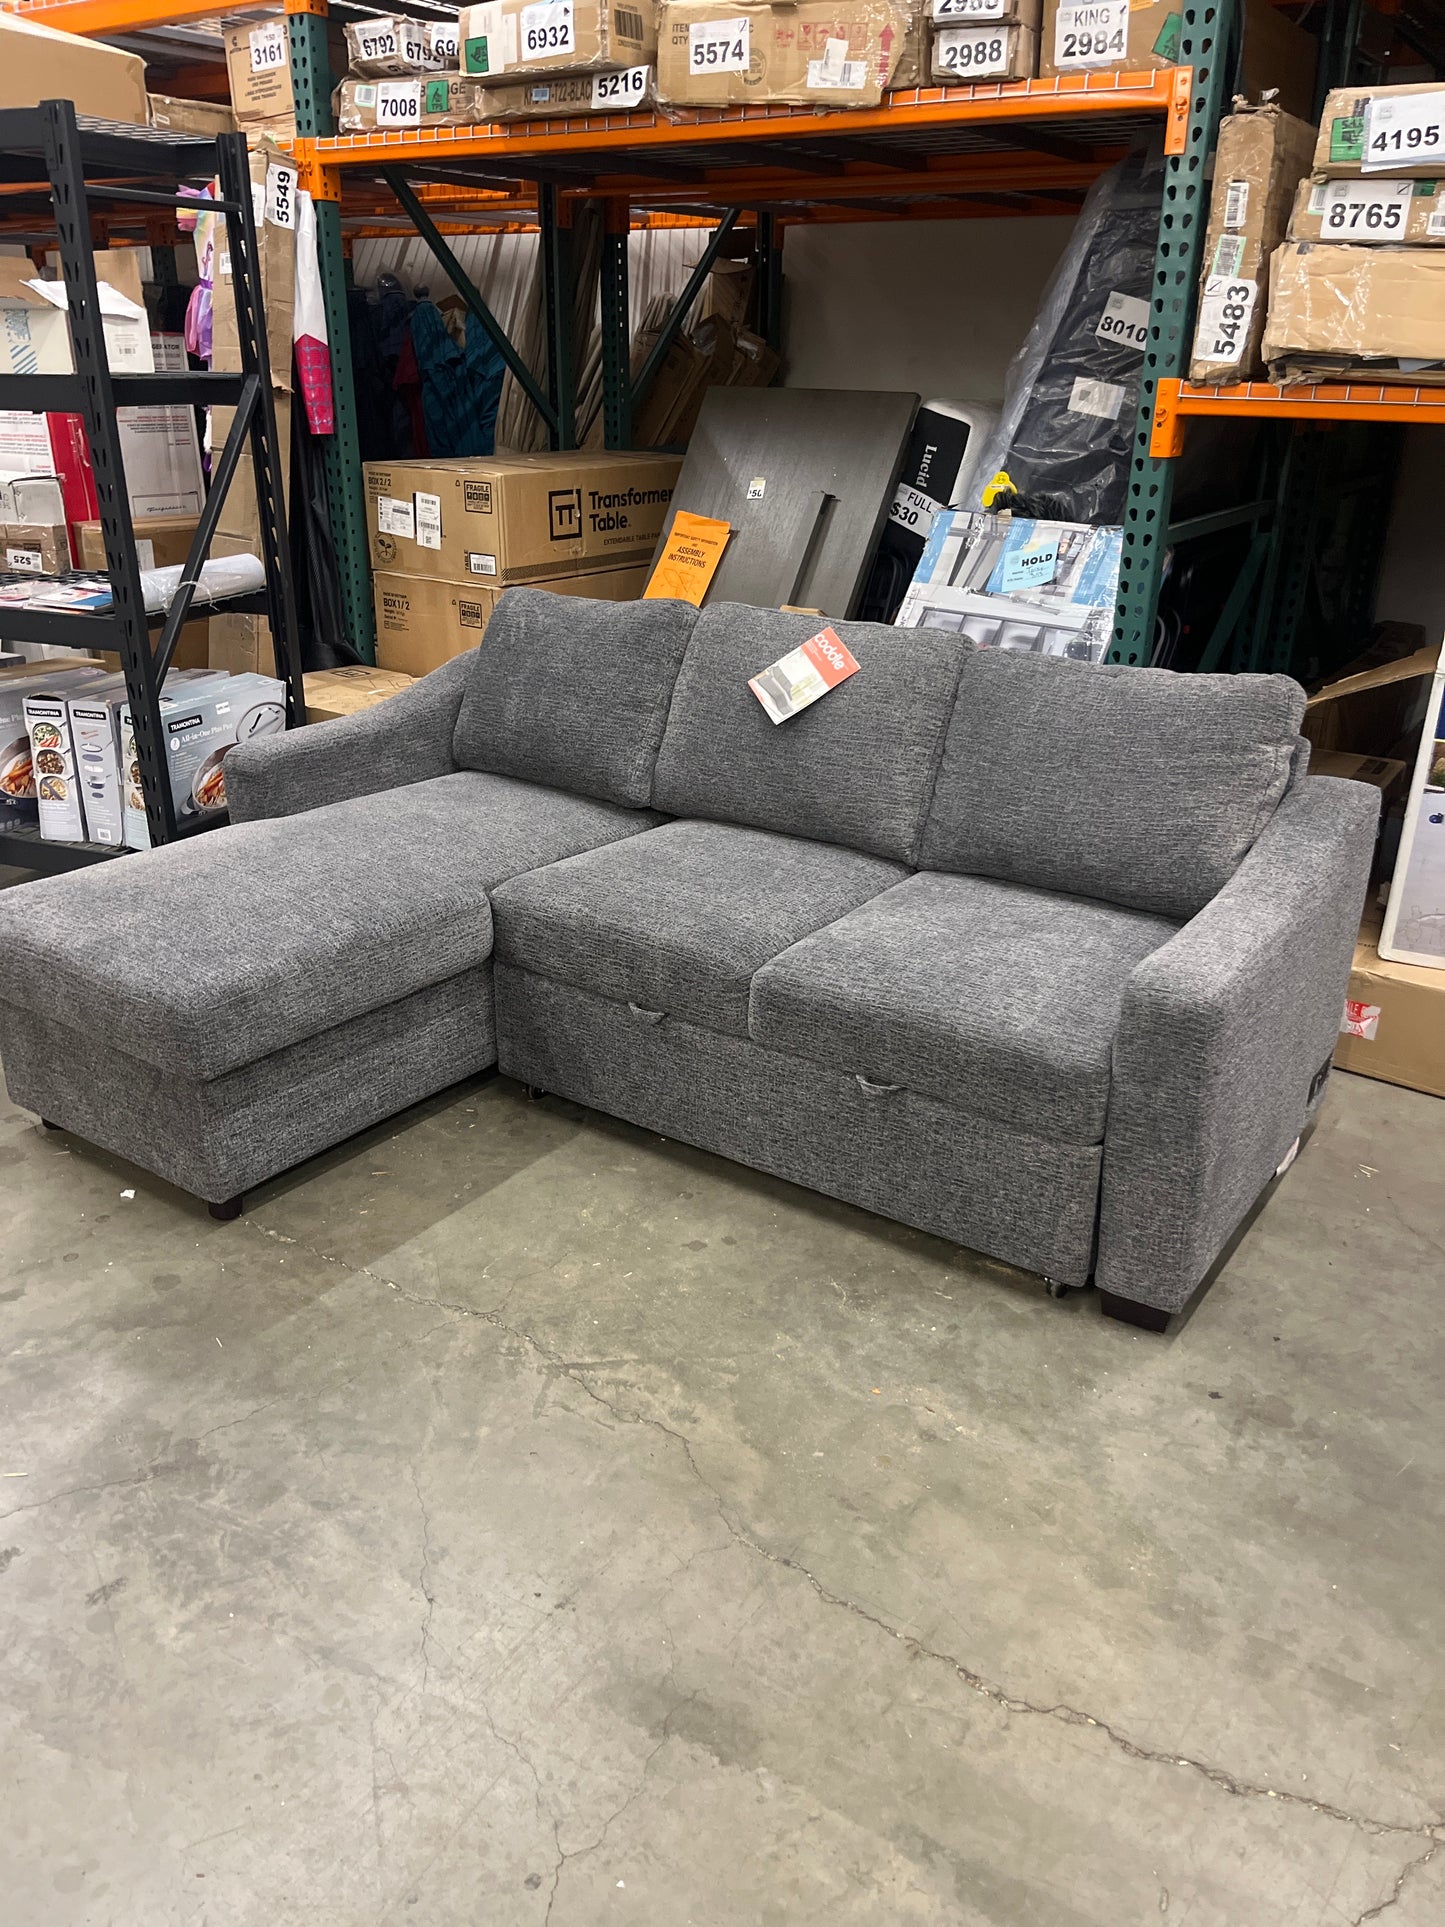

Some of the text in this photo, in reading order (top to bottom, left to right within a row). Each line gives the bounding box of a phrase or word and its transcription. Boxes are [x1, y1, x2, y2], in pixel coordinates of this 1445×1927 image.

[1073, 8, 1110, 27] KING
[363, 35, 395, 56] 6792
[435, 39, 459, 57] 69
[527, 24, 569, 50] 6932
[1062, 28, 1125, 58] 2984
[254, 43, 283, 65] 3161
[693, 39, 745, 66] 5574
[945, 39, 1002, 69] 2988
[598, 70, 643, 98] 5216
[381, 98, 417, 117] 7008
[1371, 124, 1440, 152] 4195
[276, 170, 291, 223] 5549
[1328, 202, 1402, 229] 8765
[1100, 316, 1148, 343] 8010
[1213, 285, 1250, 356] 5483
[915, 444, 938, 488] Lucid
[466, 483, 489, 492] FRAGILE
[588, 487, 674, 511] Transformer
[890, 502, 919, 526] $30
[907, 492, 933, 513] FULL
[667, 553, 706, 569] INSTRUCTIONS
[676, 545, 706, 558] ASSEMBLY
[1021, 553, 1053, 567] HOLD
[383, 597, 397, 608] BOX
[461, 603, 480, 612] FRAGILE
[814, 633, 845, 670] coddle
[170, 717, 201, 731] TRAMONTINA
[181, 729, 211, 743] All-in-One
